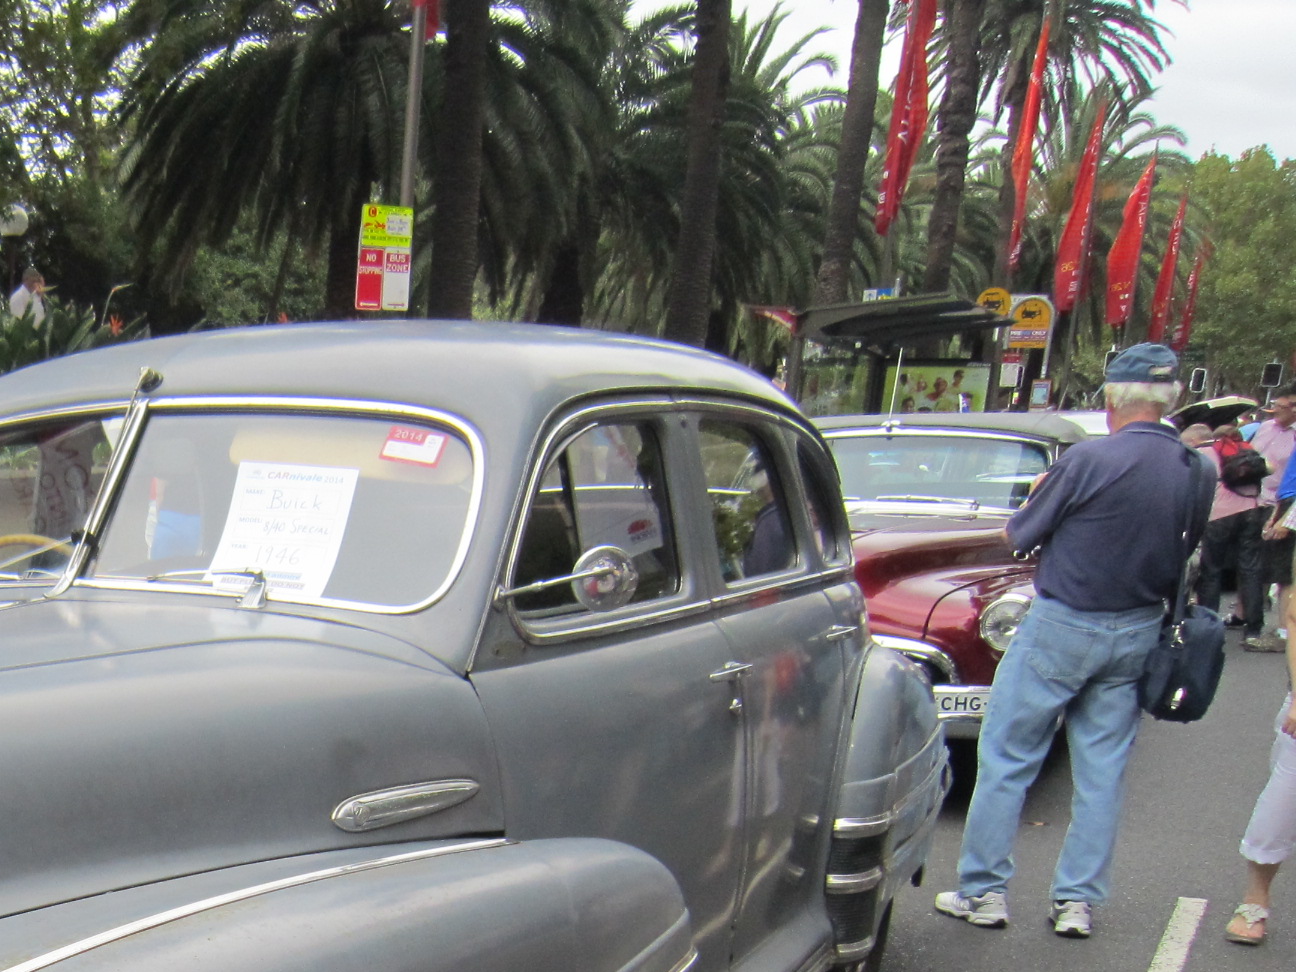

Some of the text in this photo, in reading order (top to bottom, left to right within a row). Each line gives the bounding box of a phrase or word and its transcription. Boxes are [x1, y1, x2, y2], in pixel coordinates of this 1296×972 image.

[365, 253, 377, 262] NO
[389, 254, 406, 263] BUS
[358, 266, 383, 275] STOPPING
[386, 263, 409, 273] ZONE
[394, 429, 423, 442] 2014
[267, 471, 323, 483] CARnivale
[323, 475, 344, 485] 2014
[266, 489, 323, 511] Buick
[255, 545, 301, 566] 1946
[941, 696, 981, 711] CHG
